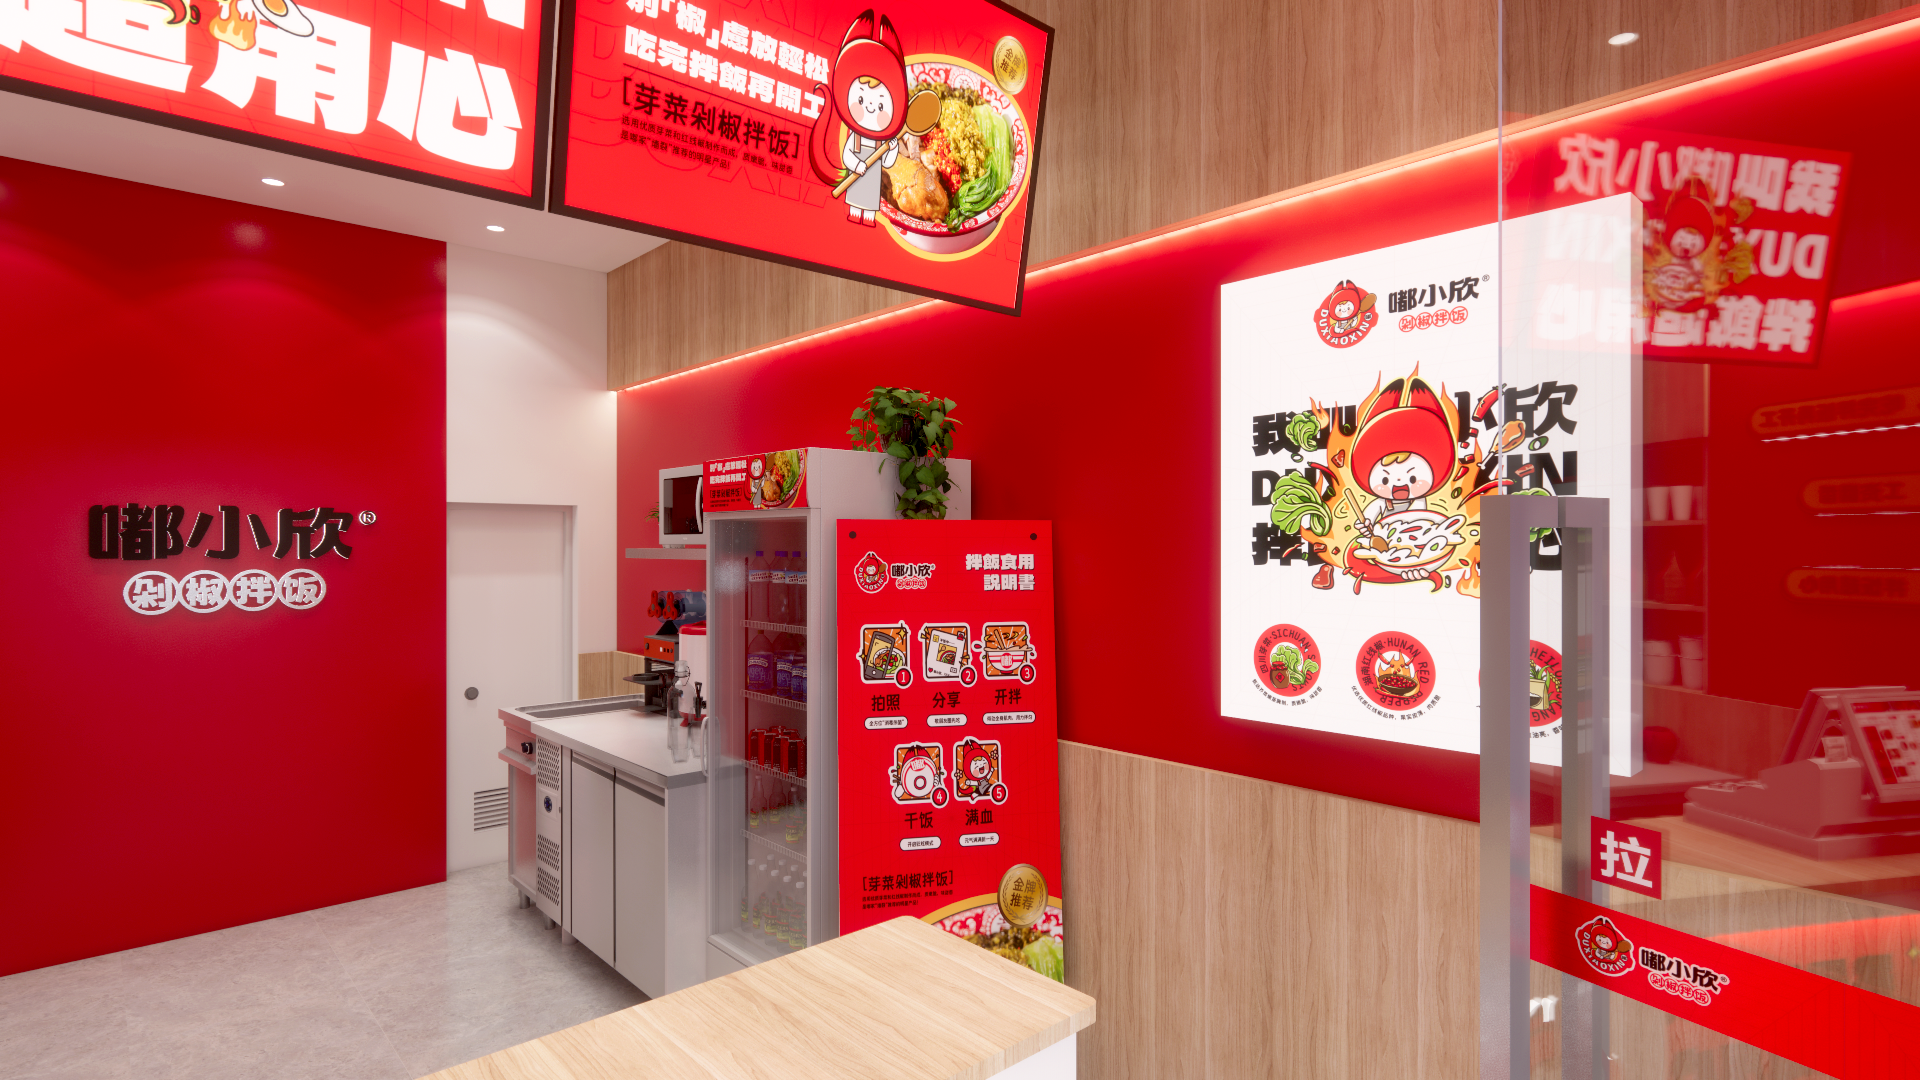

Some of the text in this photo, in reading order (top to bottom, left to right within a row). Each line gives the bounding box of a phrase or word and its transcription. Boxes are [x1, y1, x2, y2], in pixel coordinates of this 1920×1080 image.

[1400, 307, 1467, 331] 剁椒拌饭
[965, 553, 1034, 570] 拌飯食用
[127, 572, 323, 612] 剁椒拌饭
[871, 693, 900, 712] 拍照
[932, 691, 961, 709] 分享
[994, 688, 1022, 705] 开拌
[904, 811, 934, 829] 干饭
[965, 808, 993, 826] 满血
[1600, 830, 1653, 888] 拉
[1013, 876, 1037, 894] 金牌
[1010, 892, 1034, 911] 推荐
